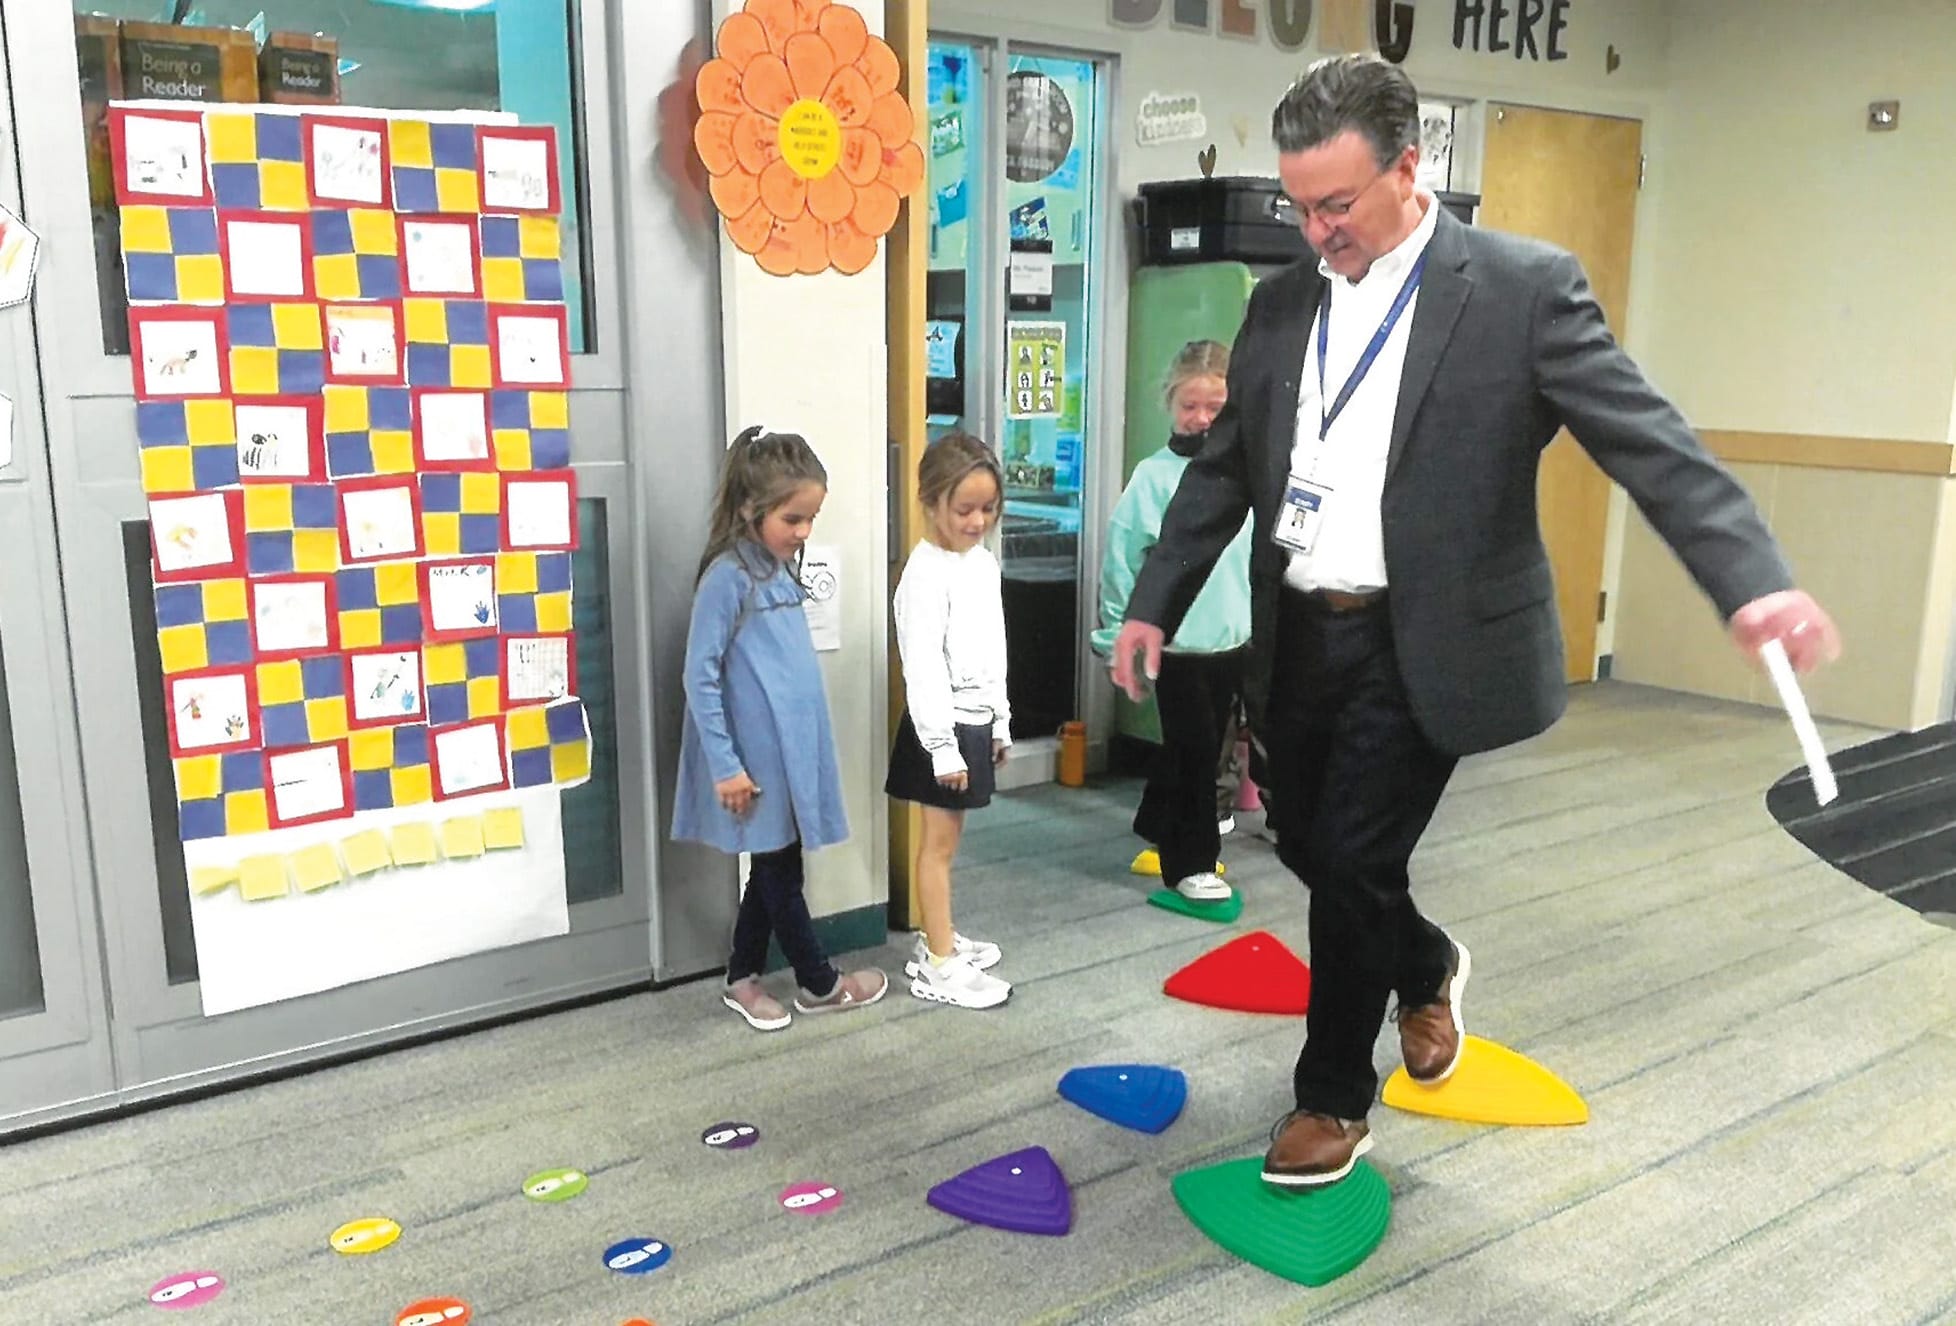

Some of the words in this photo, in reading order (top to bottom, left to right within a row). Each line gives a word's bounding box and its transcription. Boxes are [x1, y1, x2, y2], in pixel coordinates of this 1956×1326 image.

[1453, 0, 1570, 61] HERE
[142, 53, 188, 79] Being
[190, 62, 202, 74] a
[142, 76, 206, 97] Reader
[282, 71, 321, 87] Reader
[1143, 97, 1197, 118] choose
